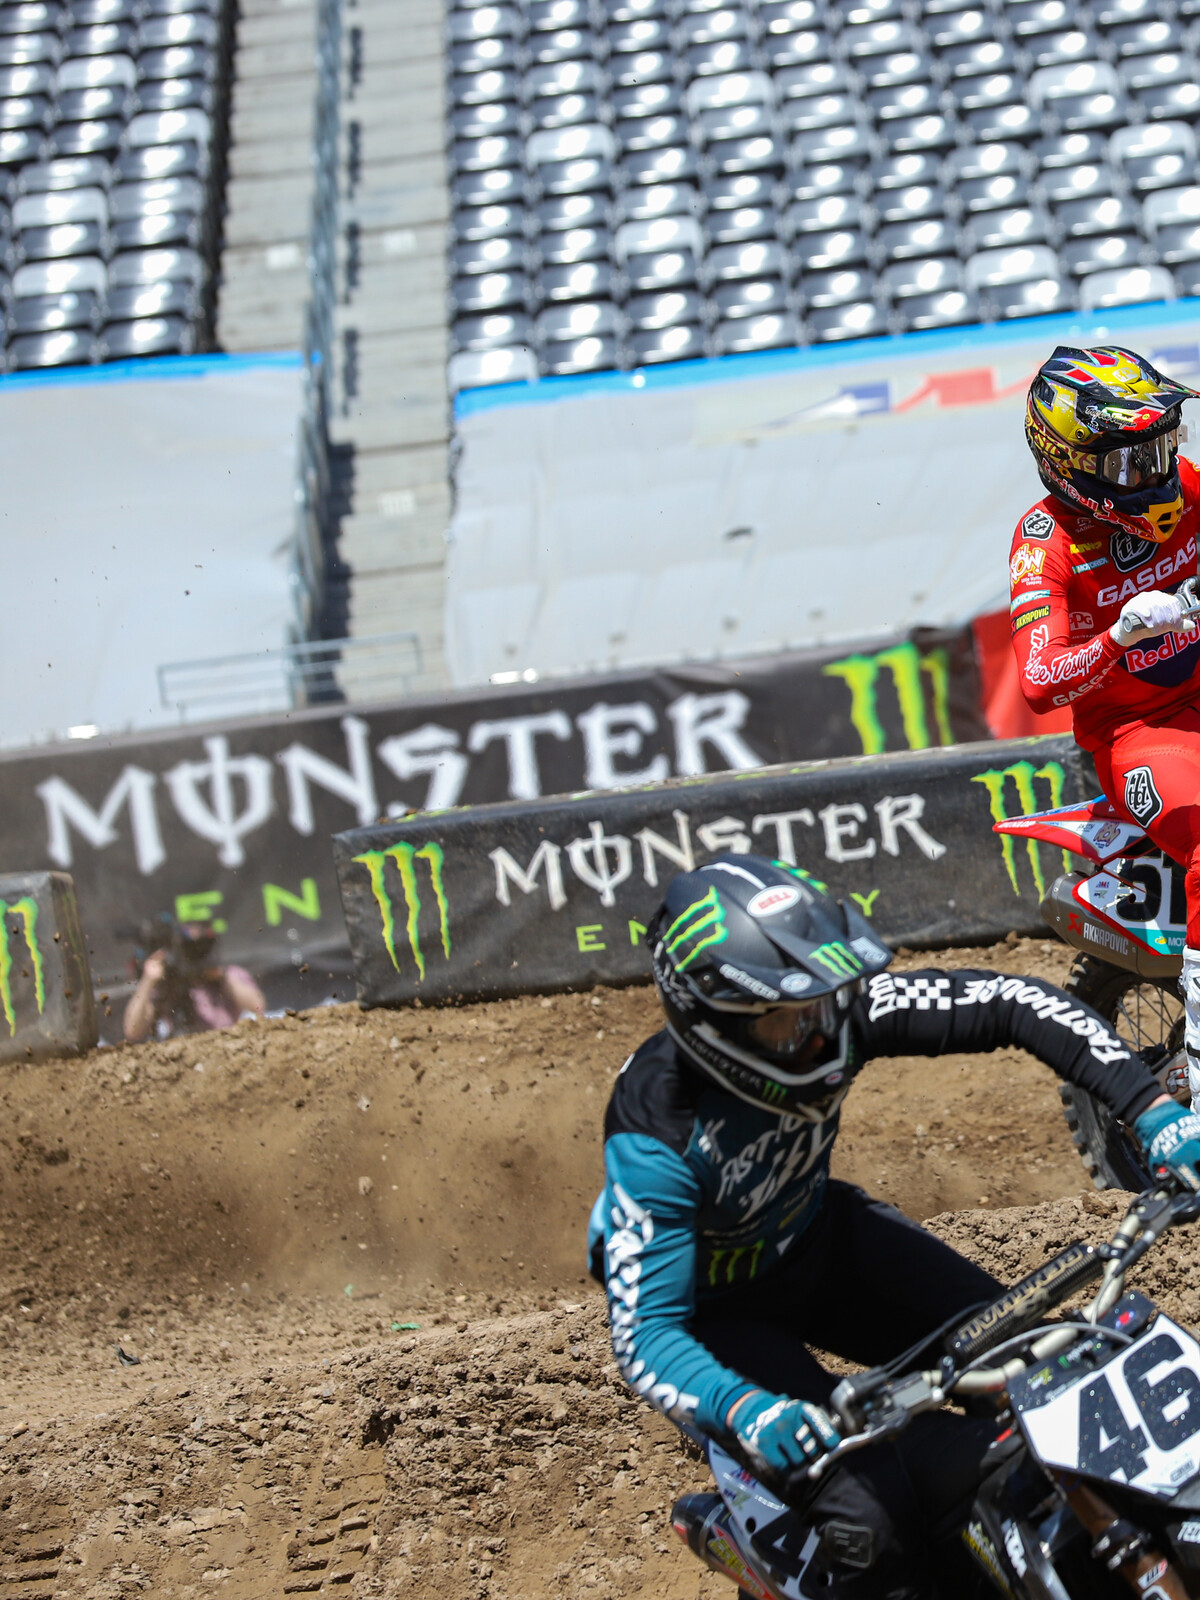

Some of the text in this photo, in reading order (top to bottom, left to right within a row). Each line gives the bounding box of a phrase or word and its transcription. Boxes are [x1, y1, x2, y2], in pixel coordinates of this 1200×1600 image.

[1042, 458, 1099, 512] Red Bull
[1097, 536, 1196, 607] GASGAS
[1125, 633, 1175, 673] Red
[36, 694, 766, 876] MONSTER
[489, 793, 946, 911] MONSTER
[1116, 857, 1188, 925] 51
[1083, 922, 1129, 956] AKRAPOVIC
[954, 975, 1131, 1065] FASTHOUSE
